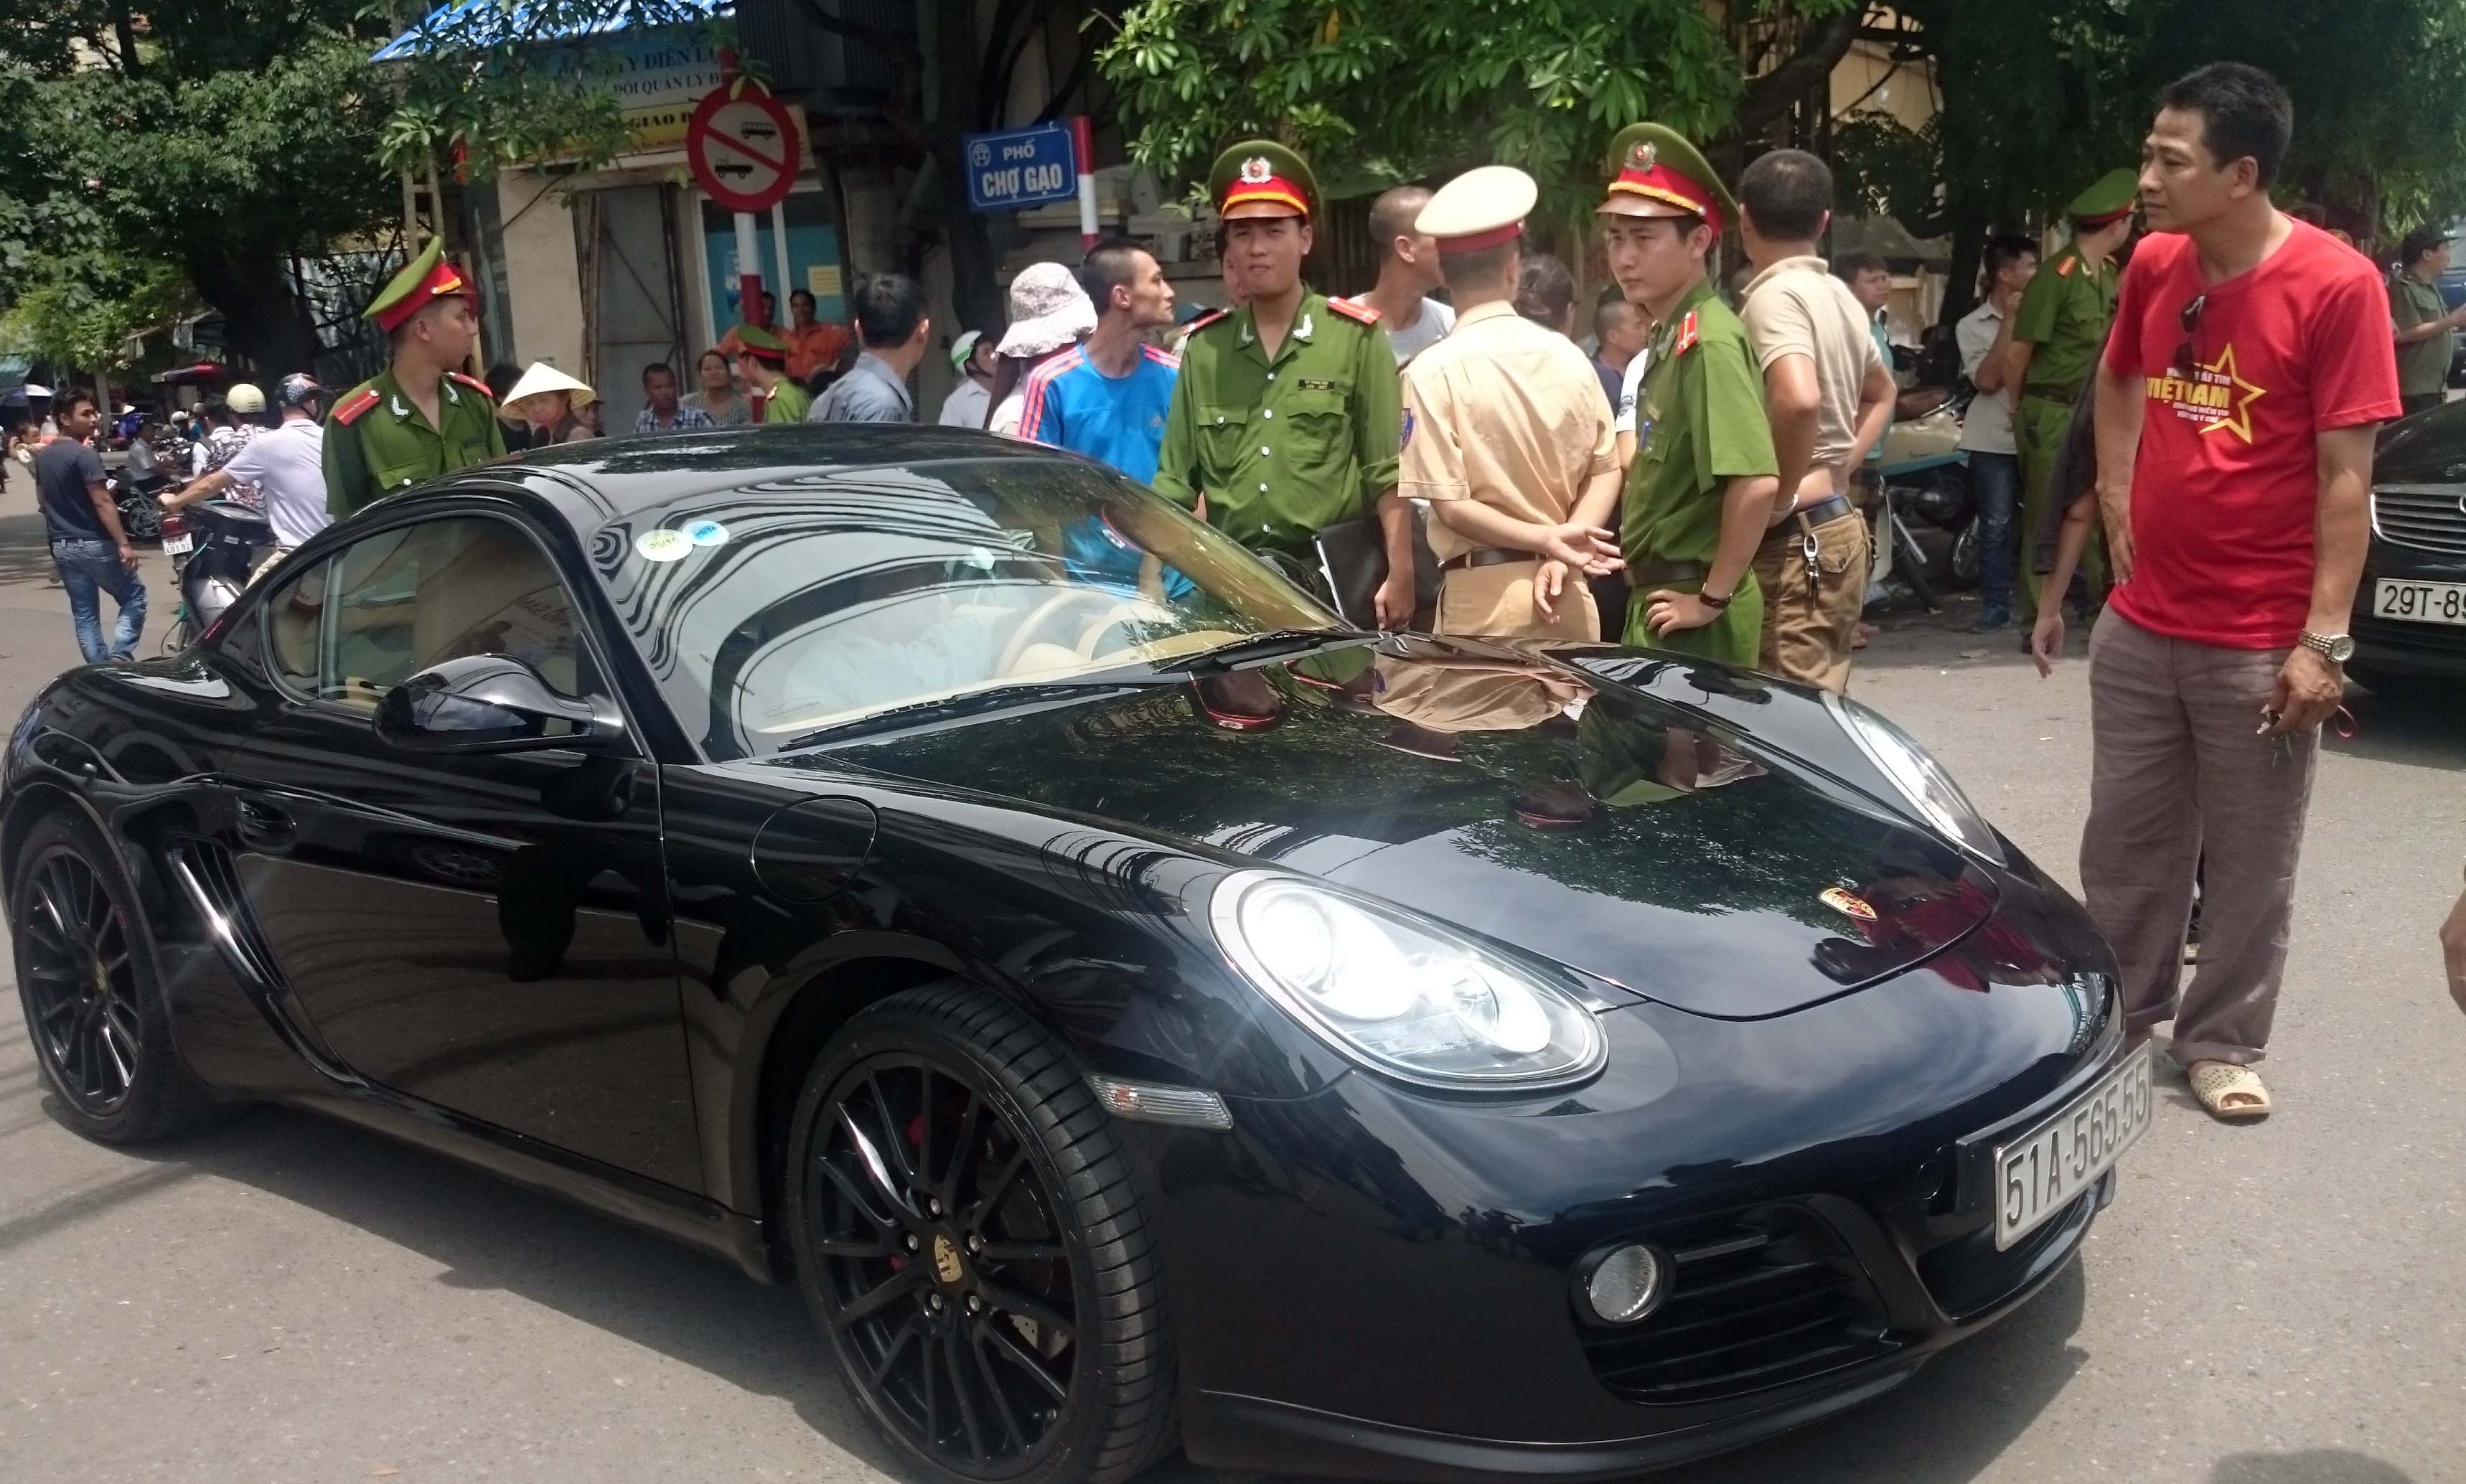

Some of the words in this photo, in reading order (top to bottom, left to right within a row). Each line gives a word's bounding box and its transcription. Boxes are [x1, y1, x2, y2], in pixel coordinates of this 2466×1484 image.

[631, 113, 675, 128] GIAO
[1003, 138, 1036, 161] PHỐ
[982, 166, 1021, 199] CHỢ
[1024, 163, 1063, 196] GẠO
[2382, 585, 2466, 619] 29T-8
[2006, 1055, 2148, 1225] 51A-565.55
